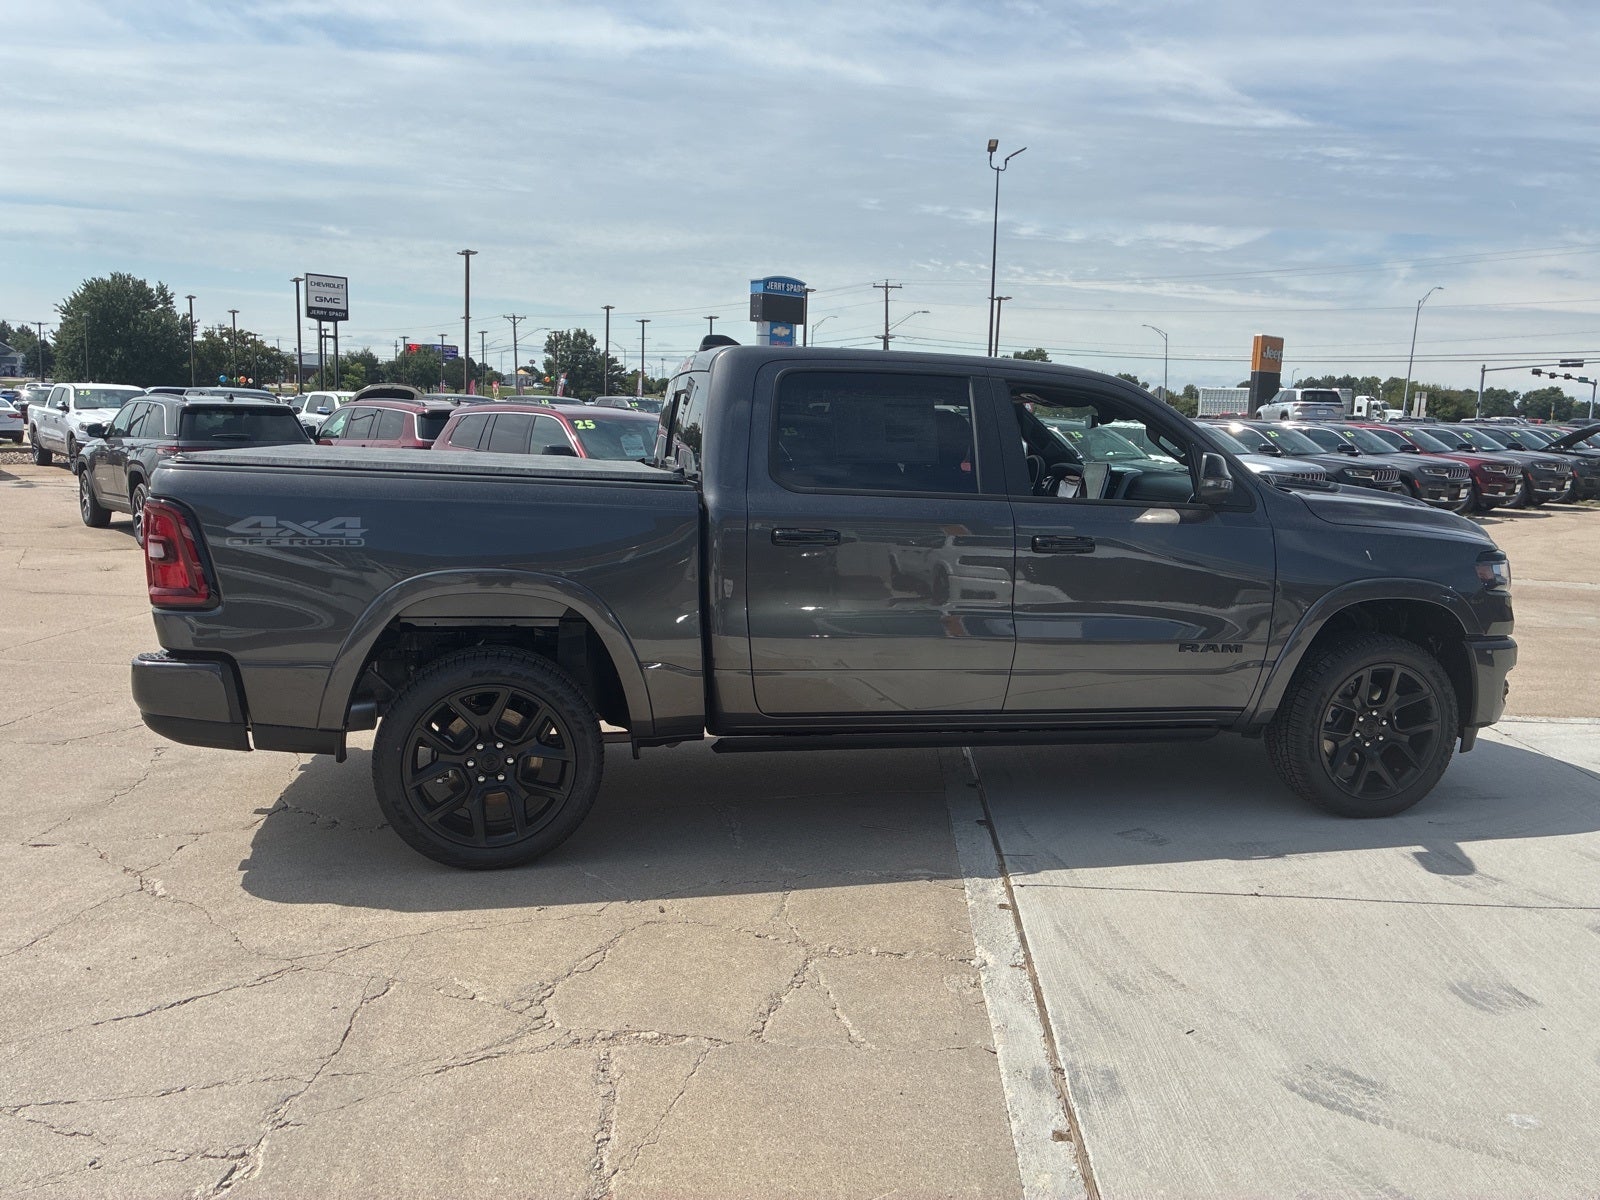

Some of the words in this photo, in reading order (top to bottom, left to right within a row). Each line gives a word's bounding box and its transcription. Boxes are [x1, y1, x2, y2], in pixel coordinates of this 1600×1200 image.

[310, 281, 344, 289] CHEVROLET
[766, 281, 785, 291] JERRY
[315, 296, 341, 304] GMC
[1262, 345, 1283, 362] Jeep
[574, 419, 596, 430] 25
[288, 538, 363, 547] ROAD
[1178, 643, 1244, 653] RAM
